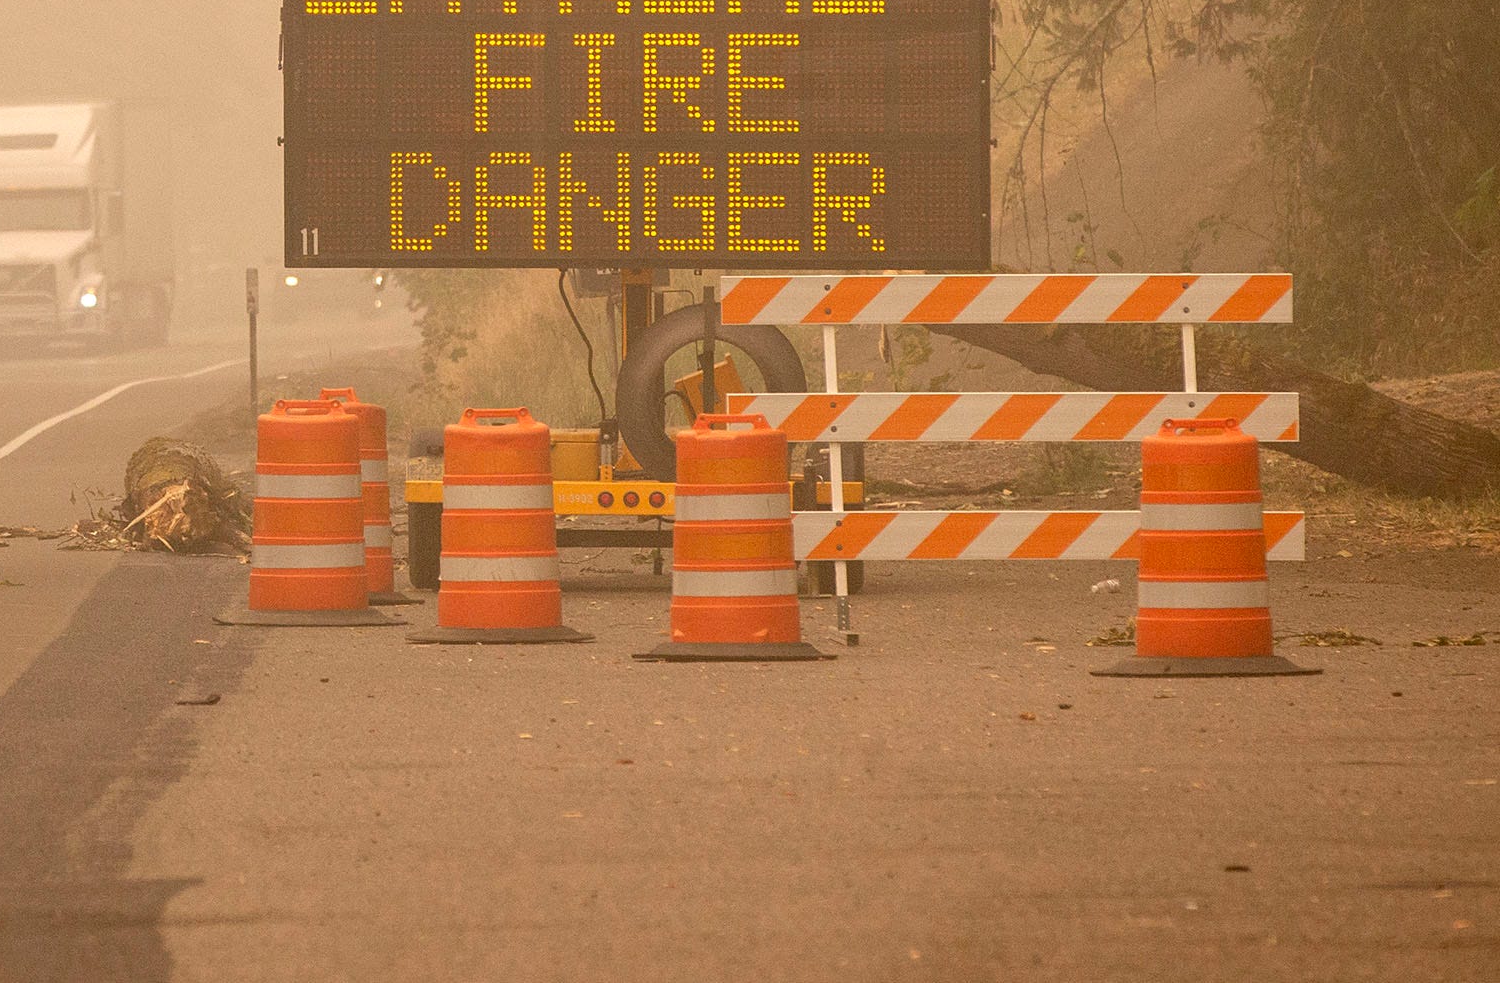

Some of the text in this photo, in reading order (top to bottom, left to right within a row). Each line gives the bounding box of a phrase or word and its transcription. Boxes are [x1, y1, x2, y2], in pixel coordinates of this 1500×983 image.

[474, 33, 800, 133] FIRE
[300, 227, 319, 256] 11
[390, 152, 885, 252] DANGER
